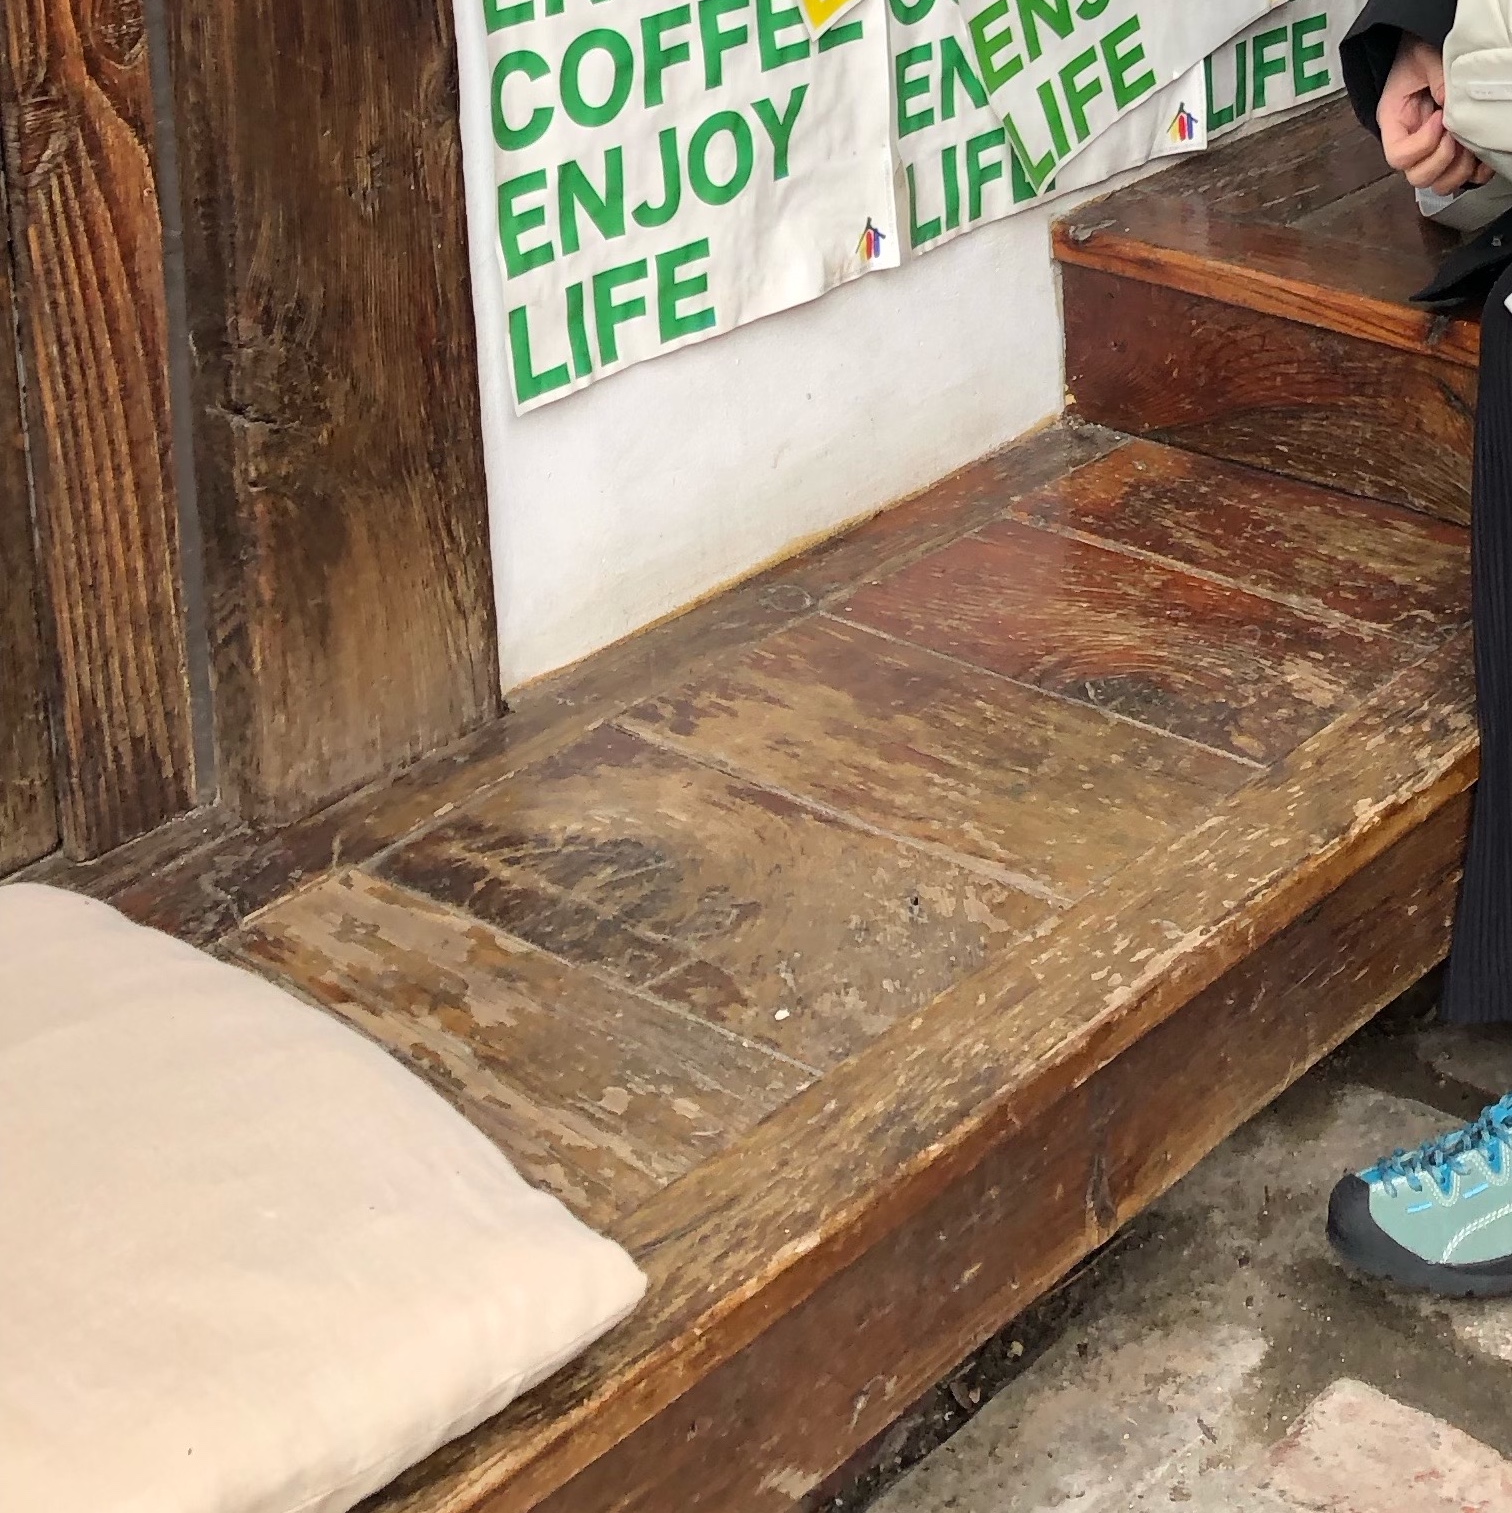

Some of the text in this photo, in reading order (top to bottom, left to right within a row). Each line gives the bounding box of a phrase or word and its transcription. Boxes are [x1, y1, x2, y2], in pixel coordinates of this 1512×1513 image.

[1002, 14, 1158, 192] LIFE
[1203, 12, 1333, 132] LIFE
[496, 83, 809, 281] ENJOY
[508, 237, 717, 405] LIFE
